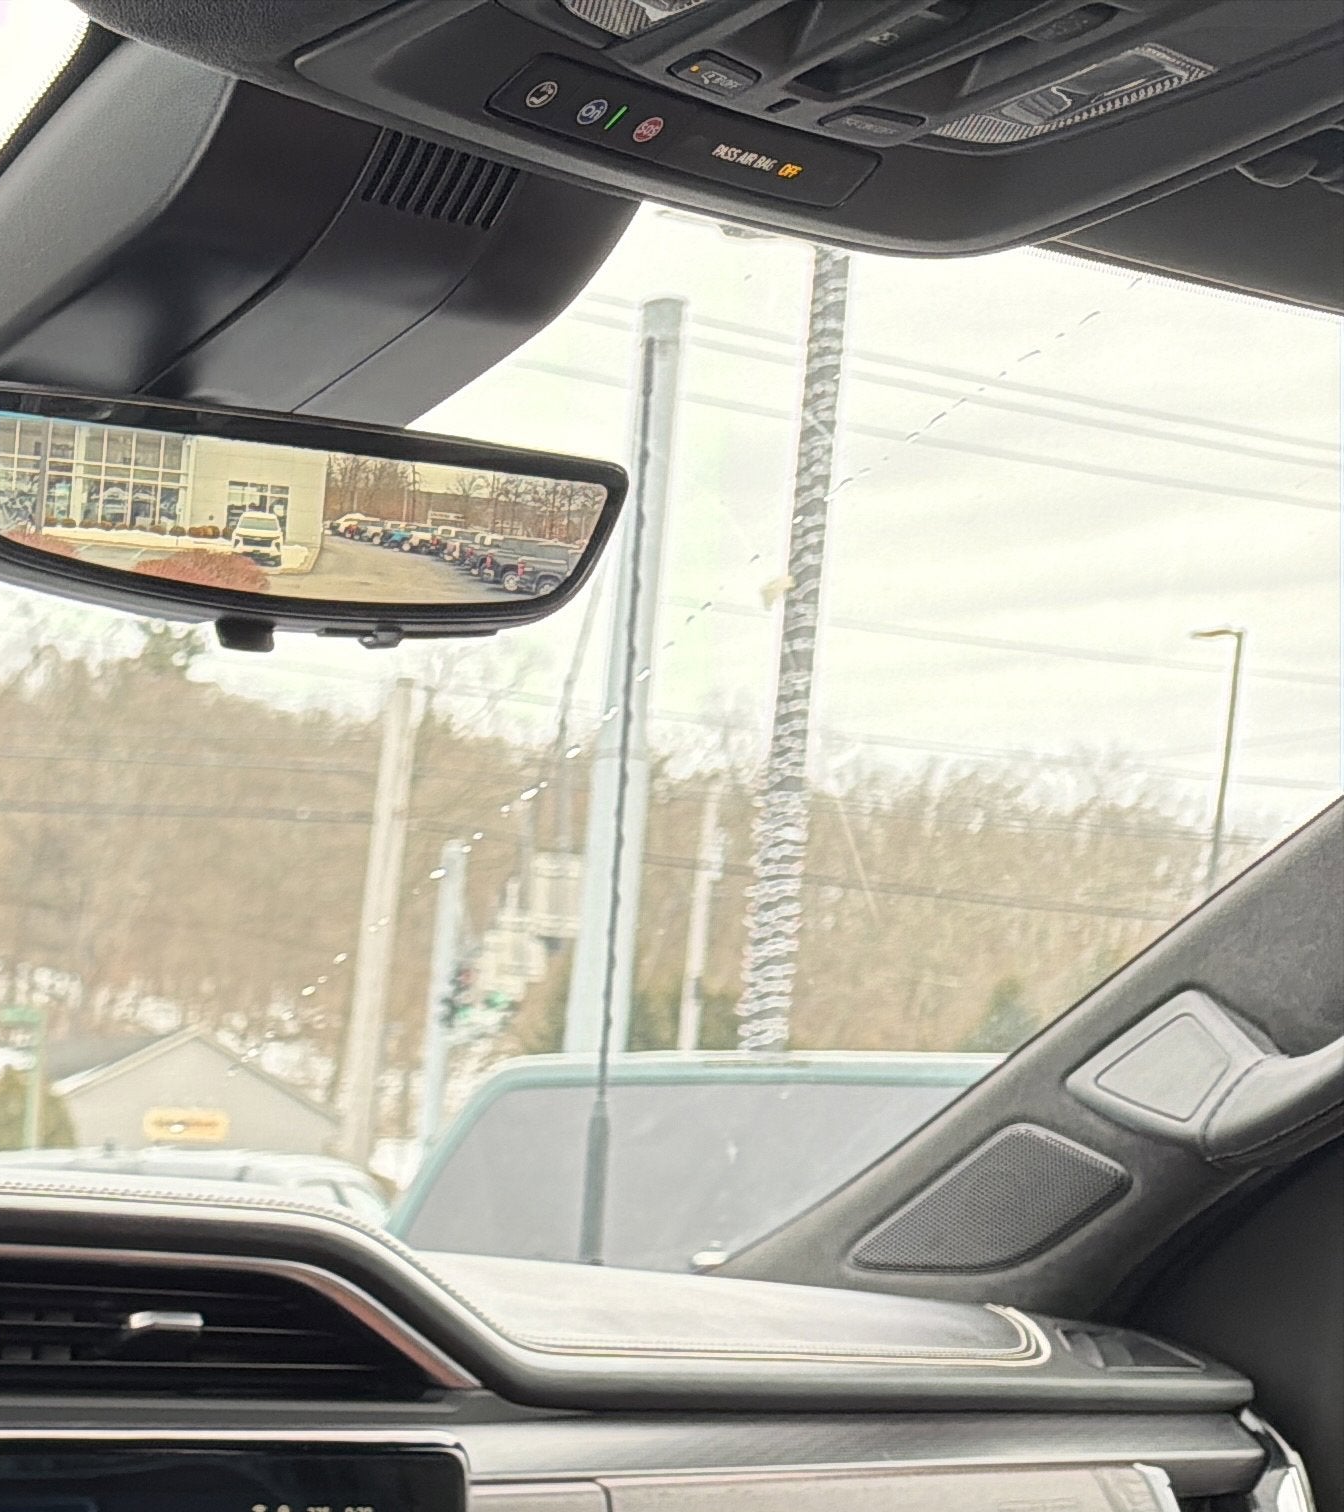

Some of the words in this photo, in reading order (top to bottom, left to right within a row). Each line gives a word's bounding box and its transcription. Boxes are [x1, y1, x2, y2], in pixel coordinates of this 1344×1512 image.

[636, 121, 660, 138] SOS
[712, 143, 742, 162] PASS
[735, 151, 758, 166] AIR
[753, 155, 778, 172] BAG
[777, 163, 803, 179] OFF
